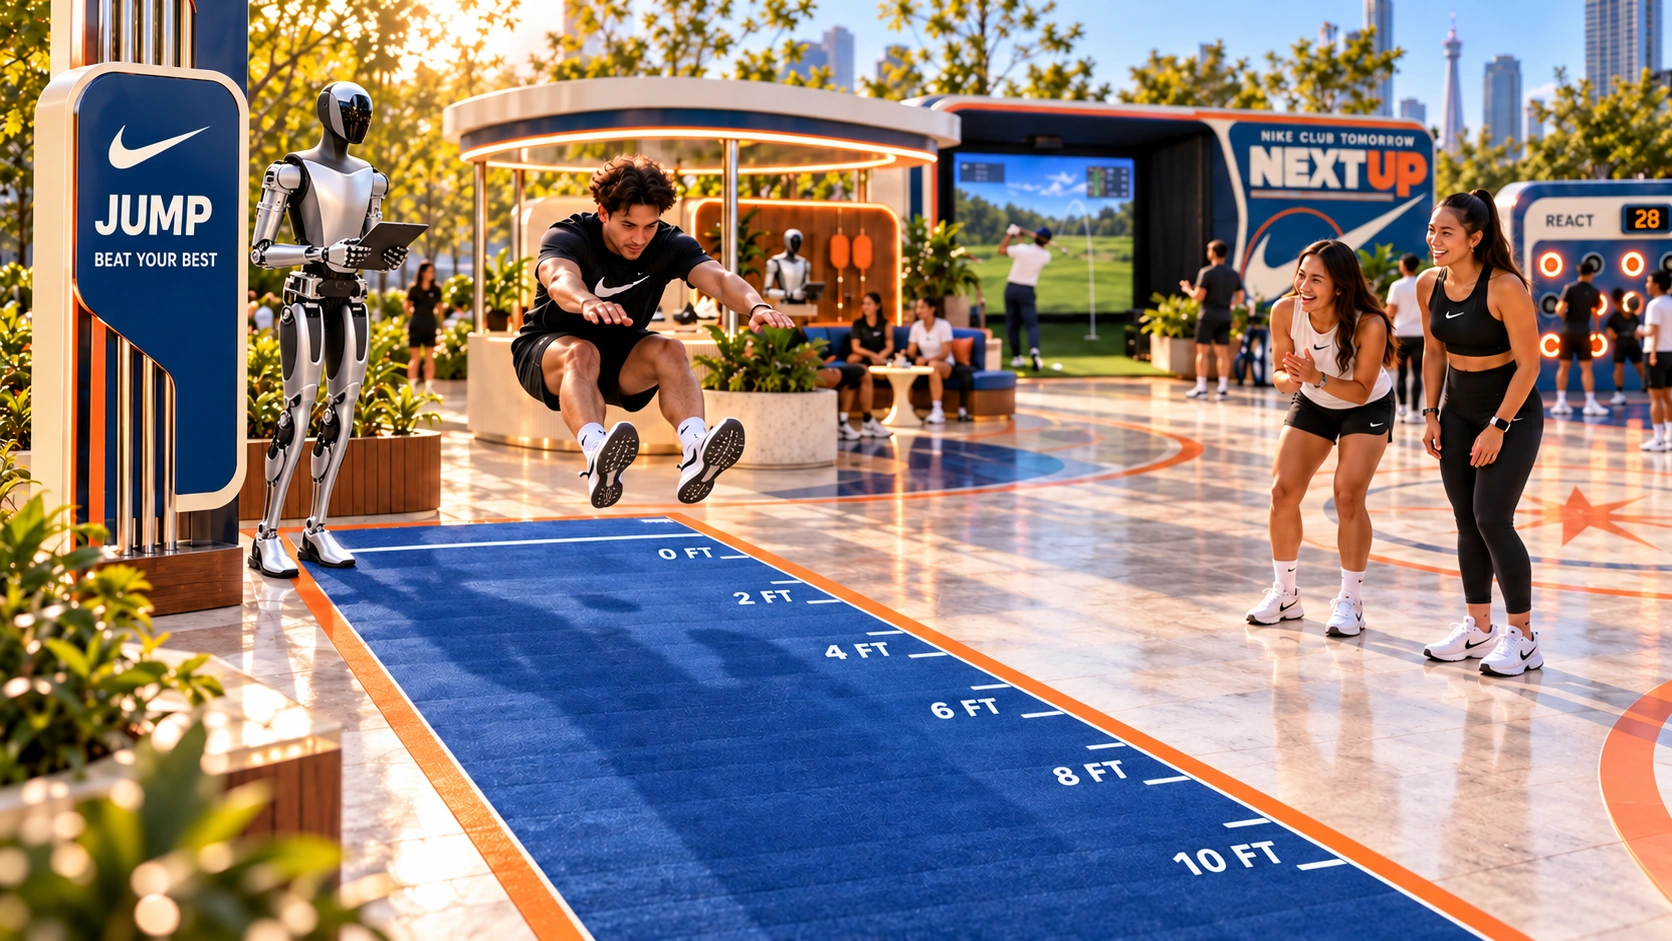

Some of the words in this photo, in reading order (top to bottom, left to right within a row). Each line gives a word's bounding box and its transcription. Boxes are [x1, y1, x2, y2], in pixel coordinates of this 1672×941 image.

[1261, 130, 1293, 143] NIKE
[1299, 131, 1334, 144] CLUB
[1340, 132, 1416, 147] TOMORROW
[95, 195, 213, 236] JUMP
[1546, 214, 1594, 227] REACT
[1634, 208, 1660, 229] 28
[95, 251, 132, 267] BEAT
[136, 252, 177, 267] YOUR
[182, 252, 218, 267] BEST
[658, 548, 677, 560] 0
[684, 547, 713, 559] FT
[733, 591, 755, 606] 2
[760, 590, 793, 604] FT
[824, 644, 848, 660] 4
[854, 641, 889, 659] FT
[930, 701, 955, 720] 6
[960, 697, 1000, 717] FT
[1052, 766, 1080, 786] 8
[1083, 760, 1127, 783] FT
[1172, 848, 1227, 876] 10
[1230, 840, 1281, 868] FT
